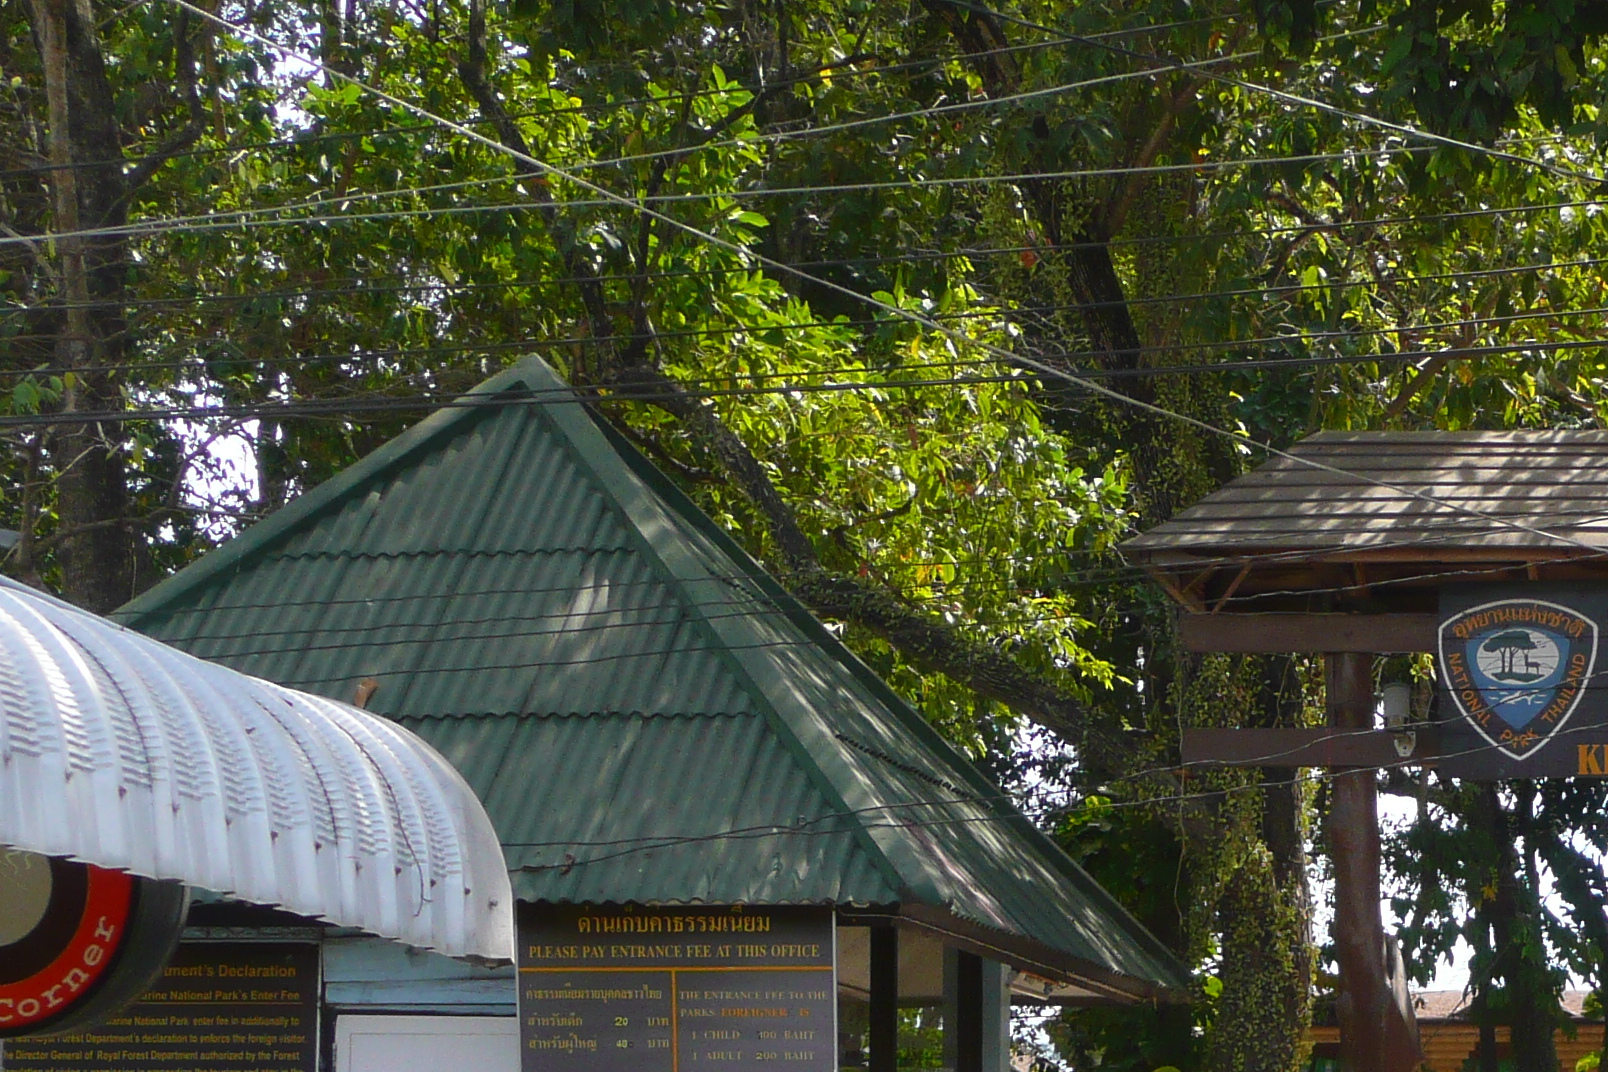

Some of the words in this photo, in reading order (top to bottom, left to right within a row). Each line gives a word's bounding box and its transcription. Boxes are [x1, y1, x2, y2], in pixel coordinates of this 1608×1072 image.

[1452, 604, 1586, 638] อุทยานแห่งชาติ
[1447, 653, 1491, 727] NATIONAL
[1541, 654, 1585, 723] THAILAND
[1500, 729, 1538, 748] PARK
[578, 905, 770, 933] ด่านเก็บค่าธรรมเนียม
[529, 945, 578, 958] PLEASE
[583, 945, 607, 958] PAY
[611, 945, 682, 958] ENTRANCE
[687, 945, 711, 958] FEE
[716, 945, 731, 958] AT
[736, 945, 767, 958] THIS
[771, 945, 820, 958] OFFICE
[218, 964, 296, 977] Declaration
[170, 990, 212, 1001] National
[215, 990, 248, 1001] Park's
[251, 990, 277, 1001] Enter
[280, 990, 300, 1001] Fee
[679, 990, 698, 1000] THE
[704, 990, 760, 1000] ENTRANCE
[765, 990, 786, 1000] FEE
[789, 990, 804, 1000] TO
[808, 990, 827, 1000] THE
[680, 1008, 715, 1017] PARKS
[721, 1008, 787, 1017] FOREIGNER
[800, 1008, 809, 1017] IS
[134, 1016, 168, 1026] National
[170, 1016, 188, 1026] Park
[193, 1016, 214, 1026] enter
[216, 1016, 229, 1026] fee
[291, 1016, 300, 1026] to
[614, 1016, 628, 1026] 20
[647, 1017, 669, 1027] บาท
[704, 1031, 740, 1040] CHILD
[784, 1031, 815, 1040] BAHT
[647, 1039, 669, 1049] บาท
[15, 1050, 48, 1060] Director
[51, 1050, 82, 1060] General
[84, 1050, 93, 1060] of
[97, 1050, 121, 1062] Royal
[122, 1050, 149, 1060] Forest
[151, 1050, 198, 1062] Department
[200, 1050, 244, 1060] authorized
[245, 1050, 256, 1062] by
[258, 1050, 271, 1060] the
[273, 1050, 300, 1060] Forest
[707, 1052, 741, 1061] ADULT
[756, 1052, 777, 1061] 200
[784, 1052, 815, 1061] BAHT
